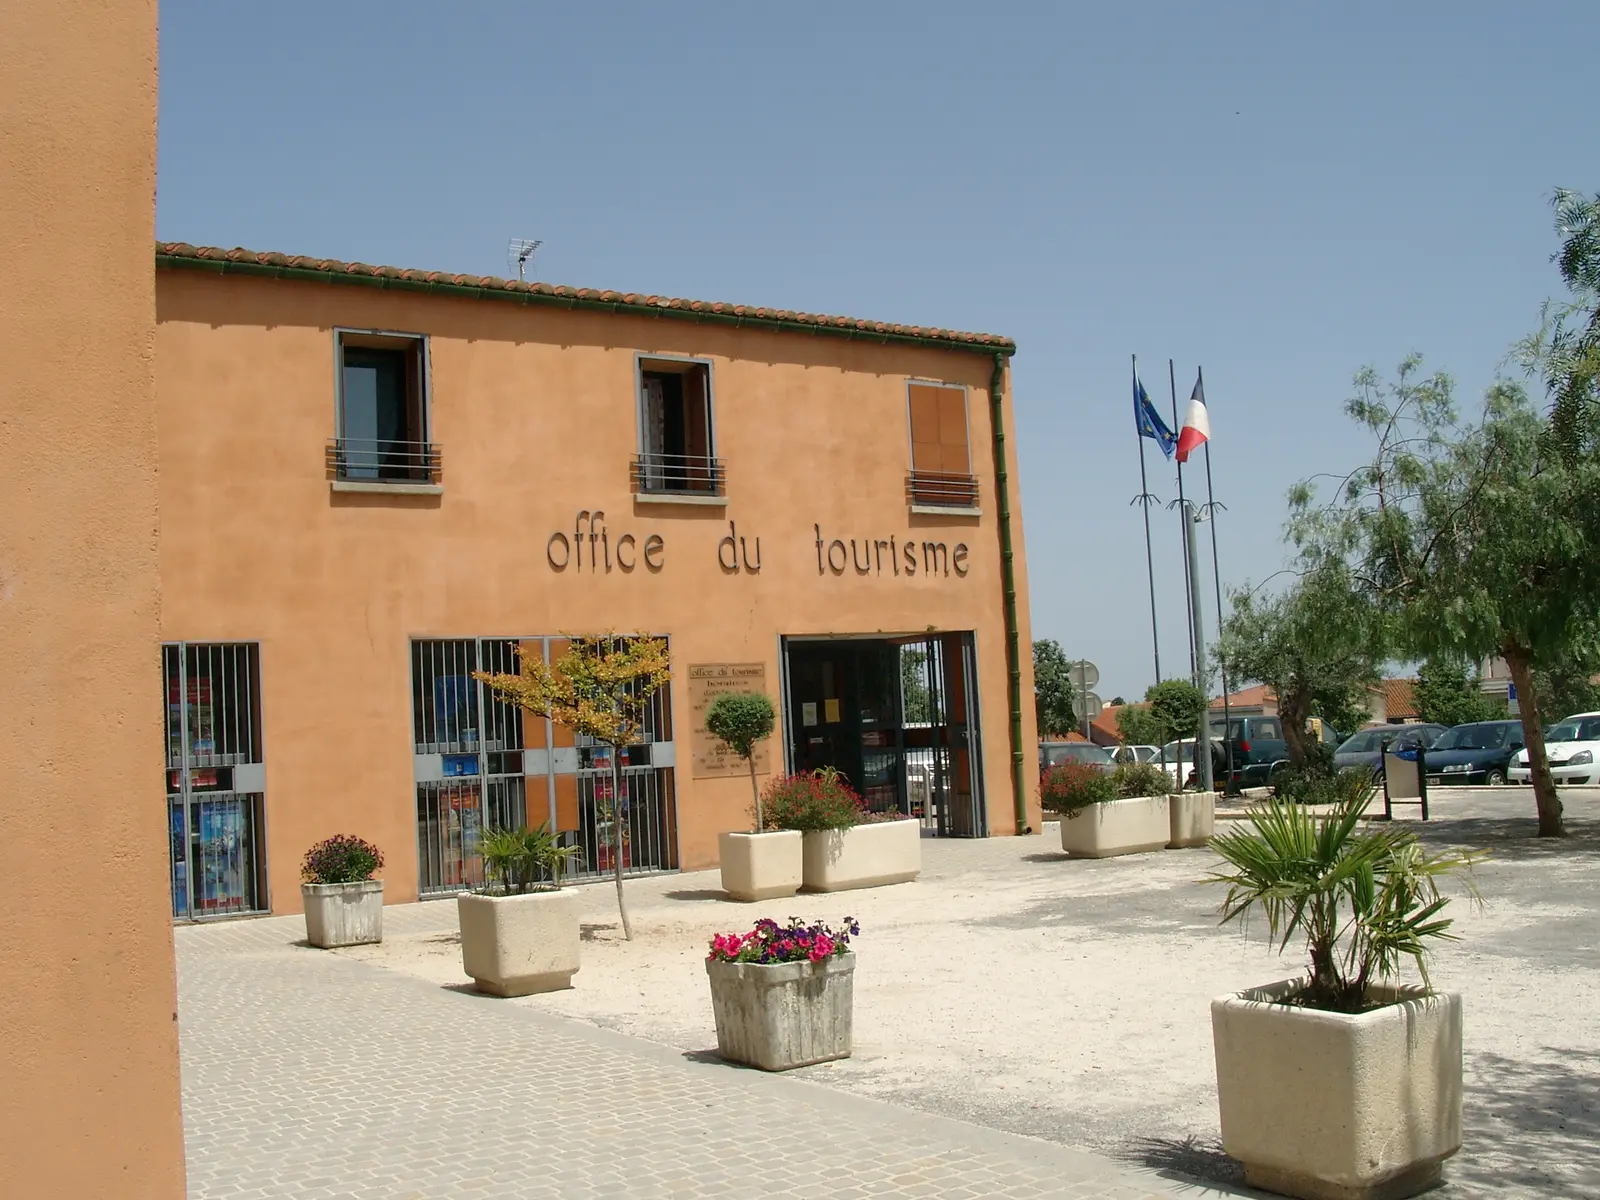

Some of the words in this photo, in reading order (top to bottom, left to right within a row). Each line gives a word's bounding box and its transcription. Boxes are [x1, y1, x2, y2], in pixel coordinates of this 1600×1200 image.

[547, 510, 664, 573] office
[718, 520, 760, 575] du
[814, 523, 969, 577] tourisme
[691, 667, 713, 677] office
